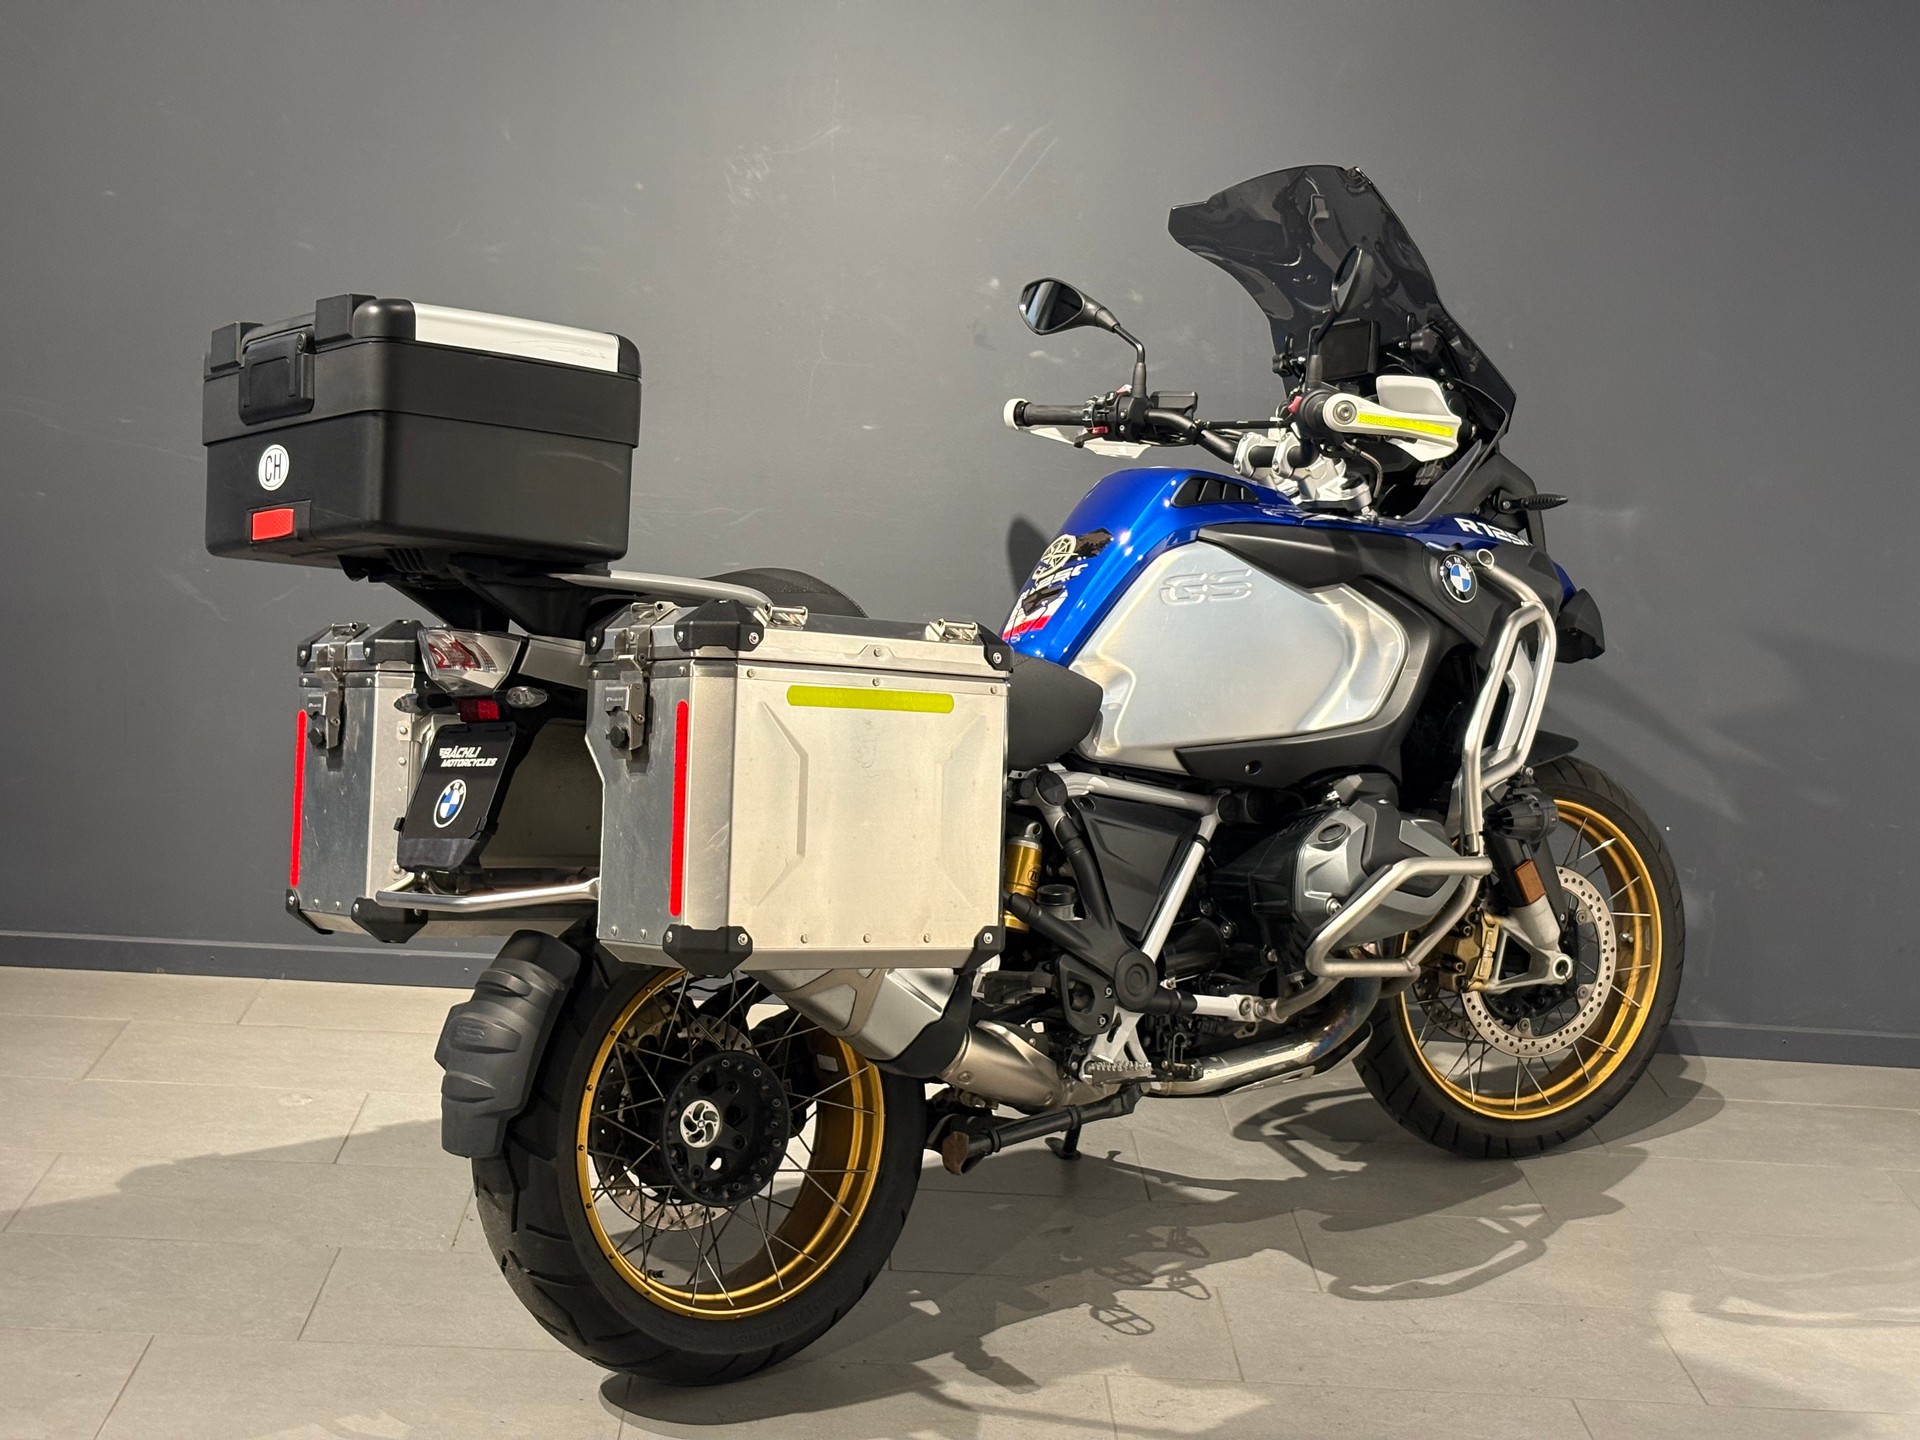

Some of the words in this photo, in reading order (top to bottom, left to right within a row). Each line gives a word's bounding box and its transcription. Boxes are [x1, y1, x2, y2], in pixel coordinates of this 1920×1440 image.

[265, 453, 281, 482] CH
[1161, 569, 1252, 605] GS
[441, 758, 498, 767] MOTORCYCLES
